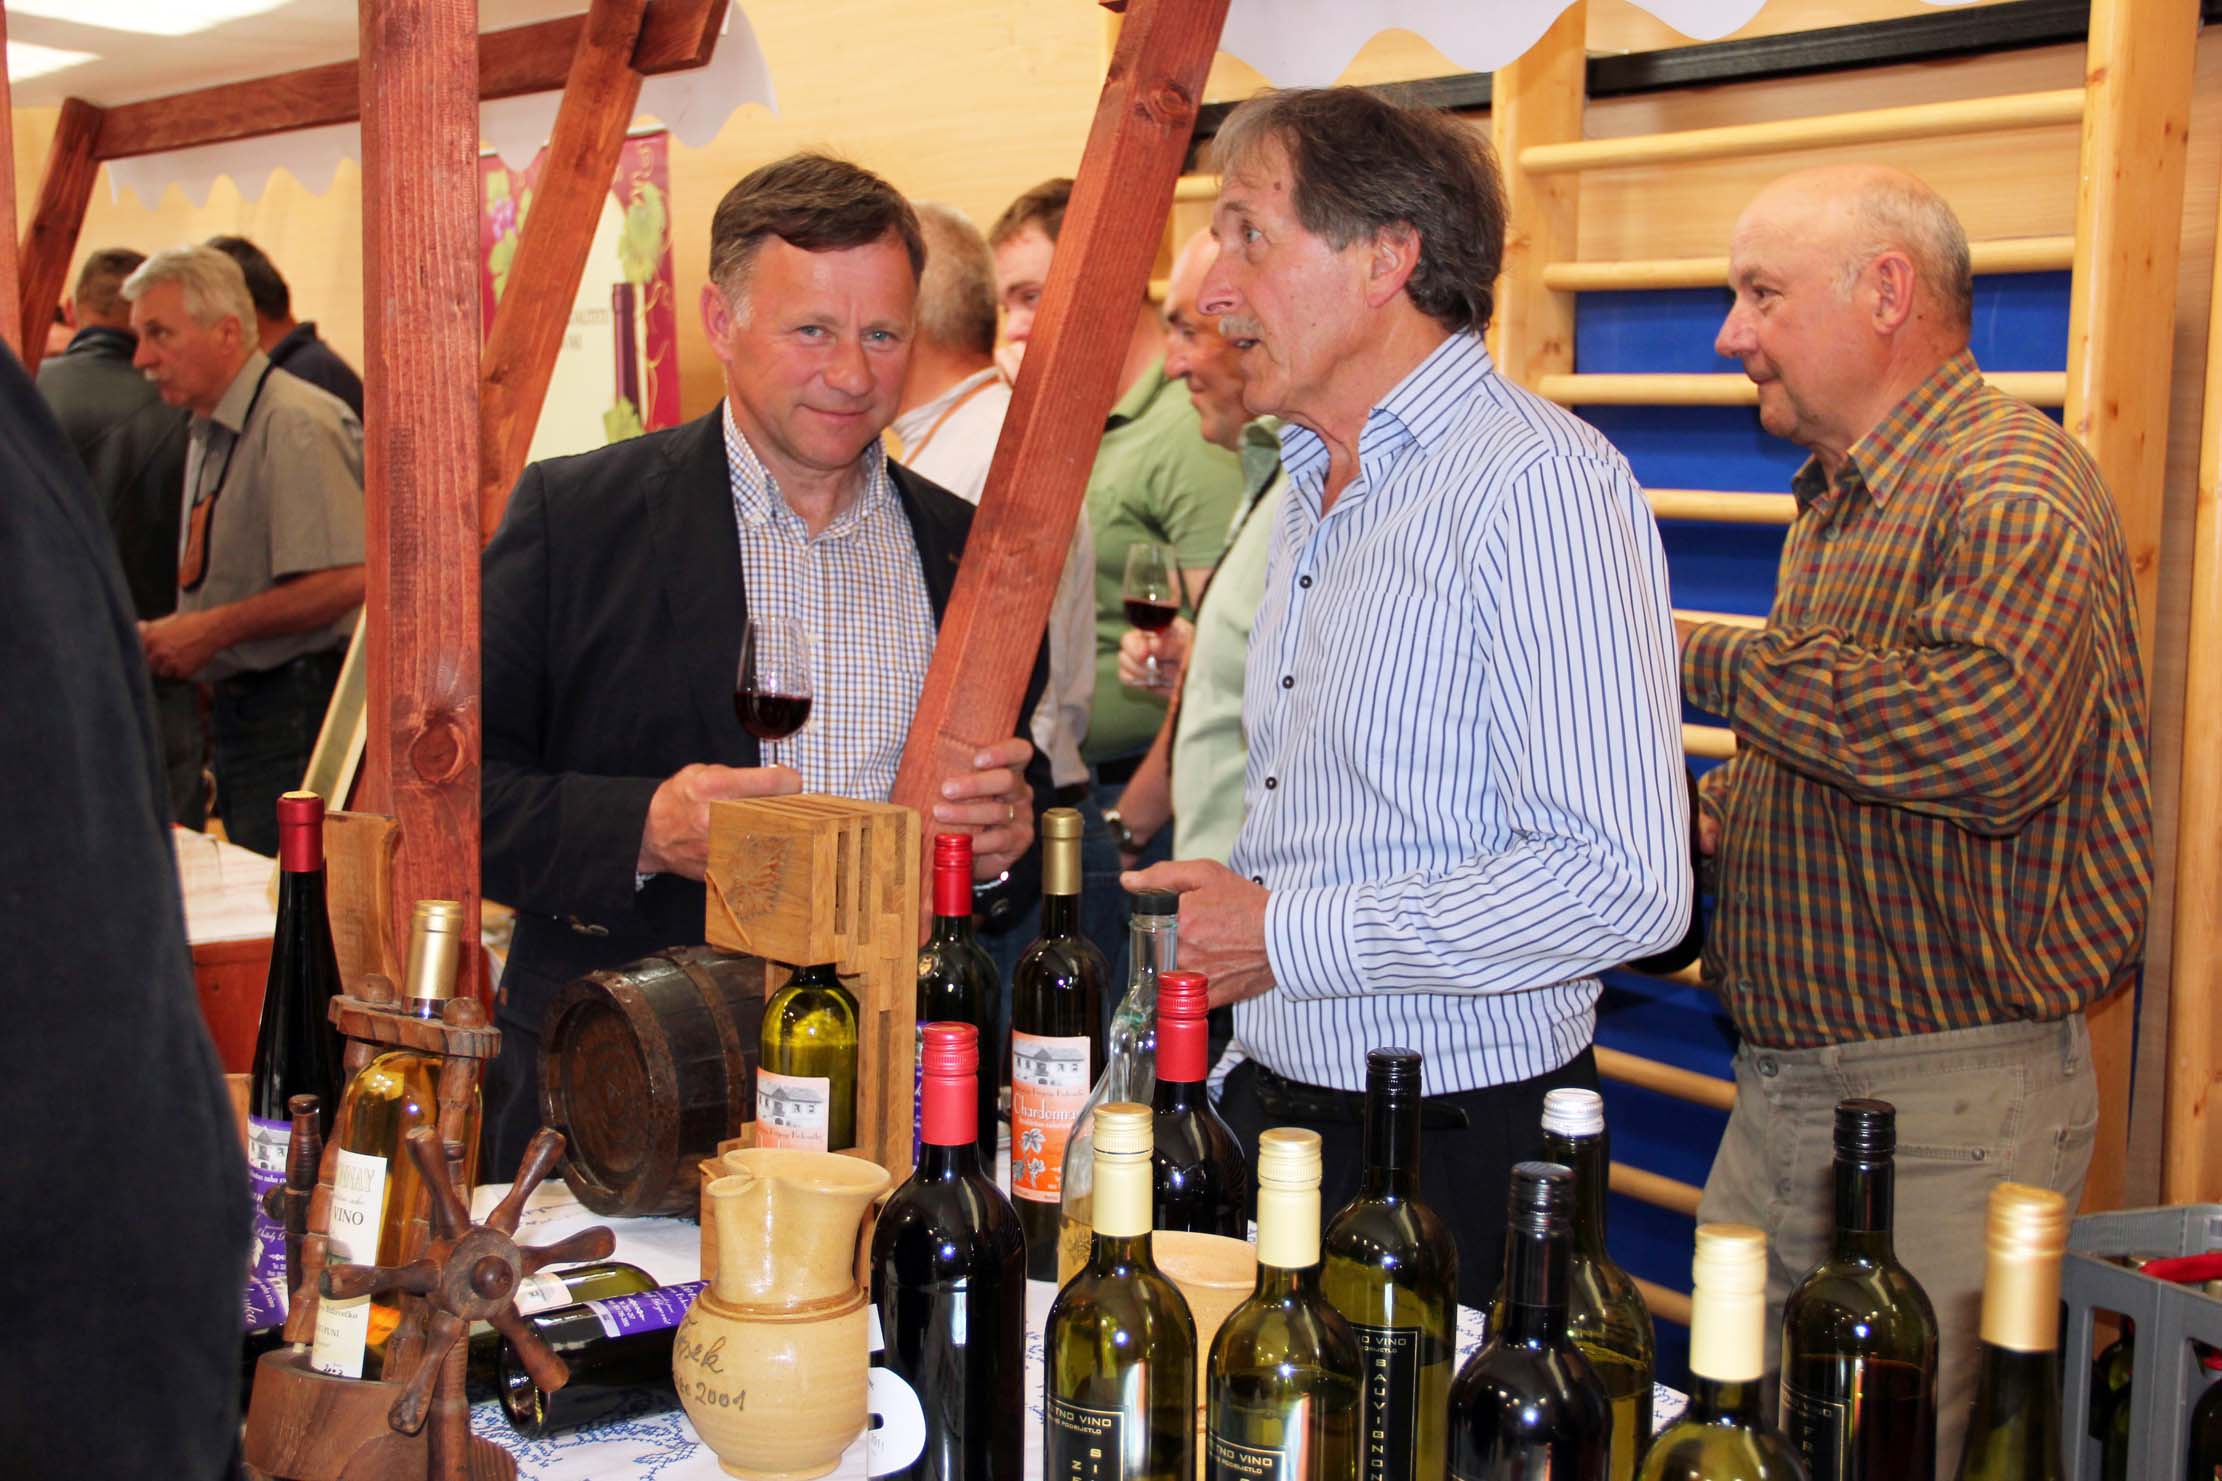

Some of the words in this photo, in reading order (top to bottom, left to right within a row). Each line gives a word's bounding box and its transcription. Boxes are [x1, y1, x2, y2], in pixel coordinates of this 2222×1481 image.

[1014, 1093, 1081, 1121] Chardonna
[1375, 1336, 1407, 1346] VINO
[1079, 1415, 1112, 1428] VINO
[1370, 1358, 1387, 1481] SAUVIGNON
[1239, 1452, 1273, 1468] VINO
